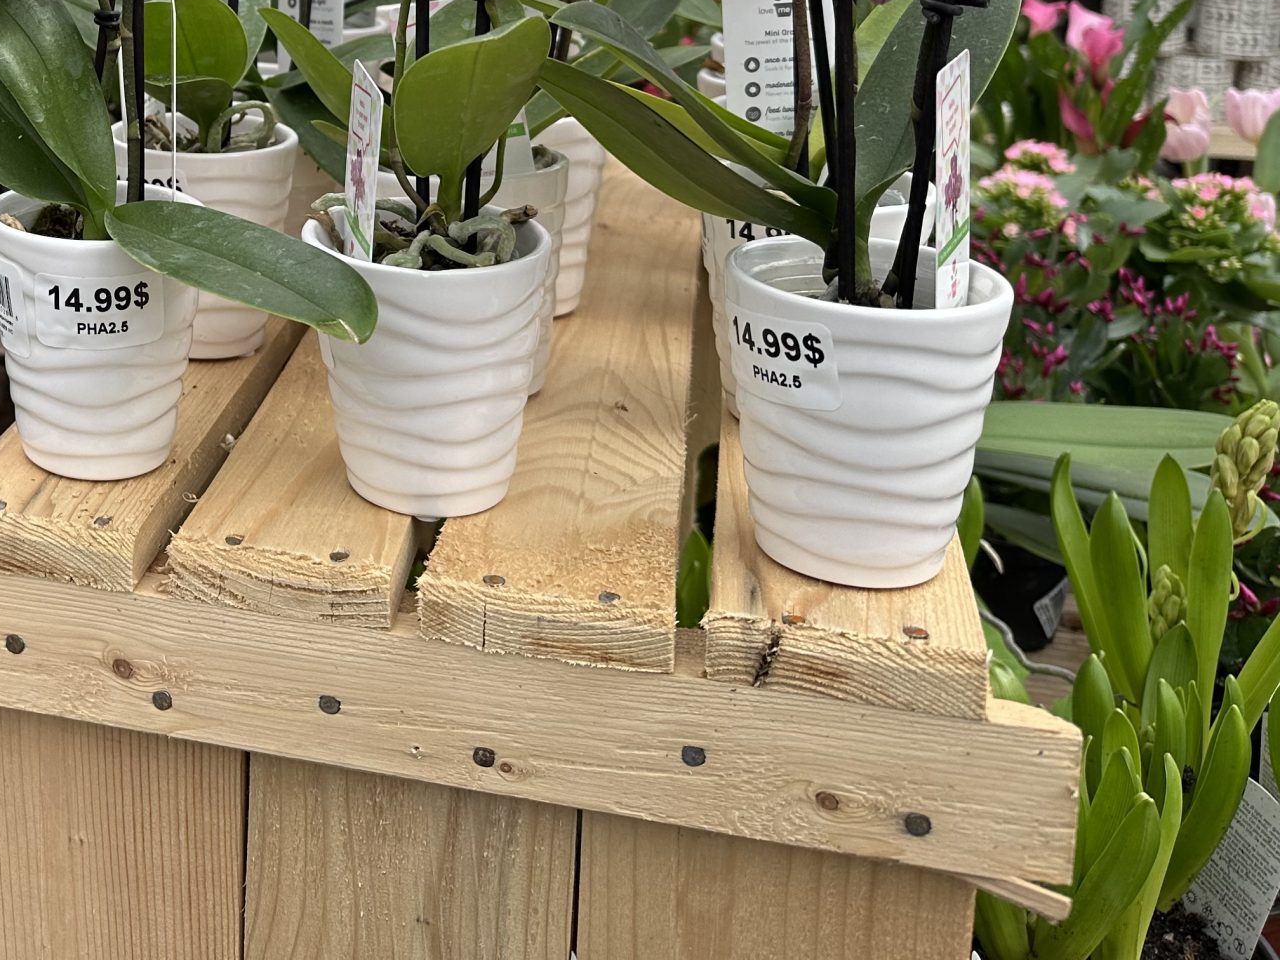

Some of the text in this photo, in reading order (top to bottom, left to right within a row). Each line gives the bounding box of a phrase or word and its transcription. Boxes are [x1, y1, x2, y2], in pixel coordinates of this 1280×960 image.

[758, 7, 774, 15] love
[764, 29, 780, 37] Mini
[48, 280, 150, 313] 14.99$
[76, 320, 129, 335] PHA2.5
[732, 315, 825, 369] 14.99$
[752, 364, 802, 389] PHA2.5
